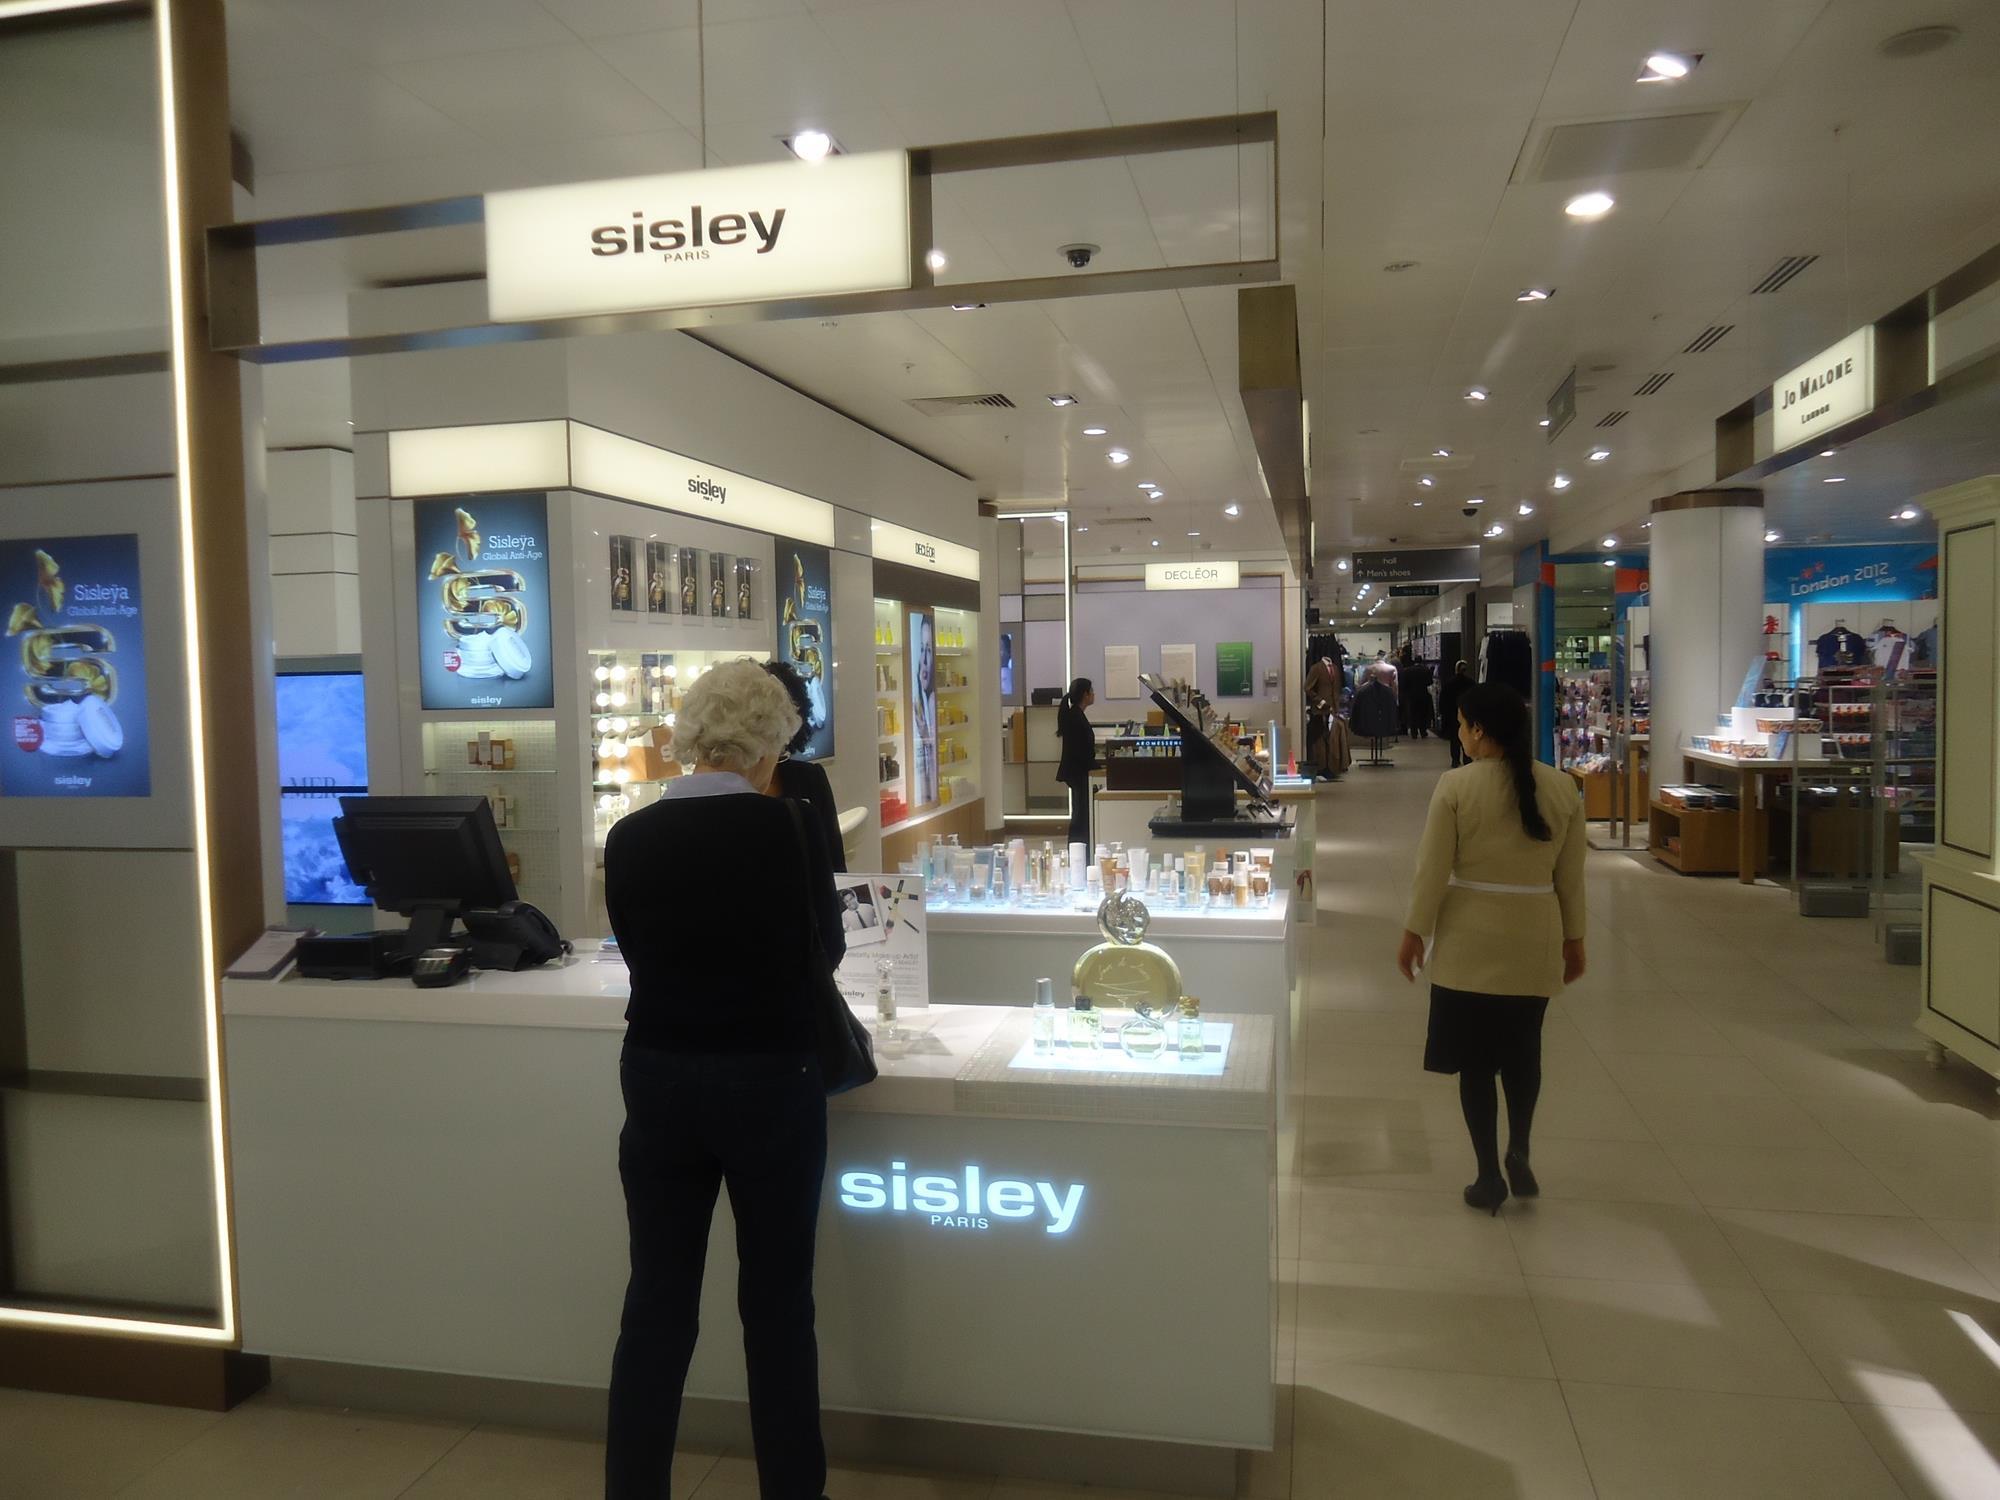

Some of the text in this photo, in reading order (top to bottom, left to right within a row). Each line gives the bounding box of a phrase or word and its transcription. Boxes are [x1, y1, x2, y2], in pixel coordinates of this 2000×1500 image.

[591, 205, 786, 256] sisley
[664, 250, 710, 263] PARIS
[1800, 358, 1852, 400] MALONE
[688, 475, 726, 504] sisley
[1366, 568, 1411, 577] Men's shoes
[1791, 562, 1889, 596] London 2012
[471, 695, 502, 705] sisley
[54, 775, 92, 787] sisley
[840, 1162, 1084, 1232] sisley
[931, 1214, 989, 1229] PARIS
